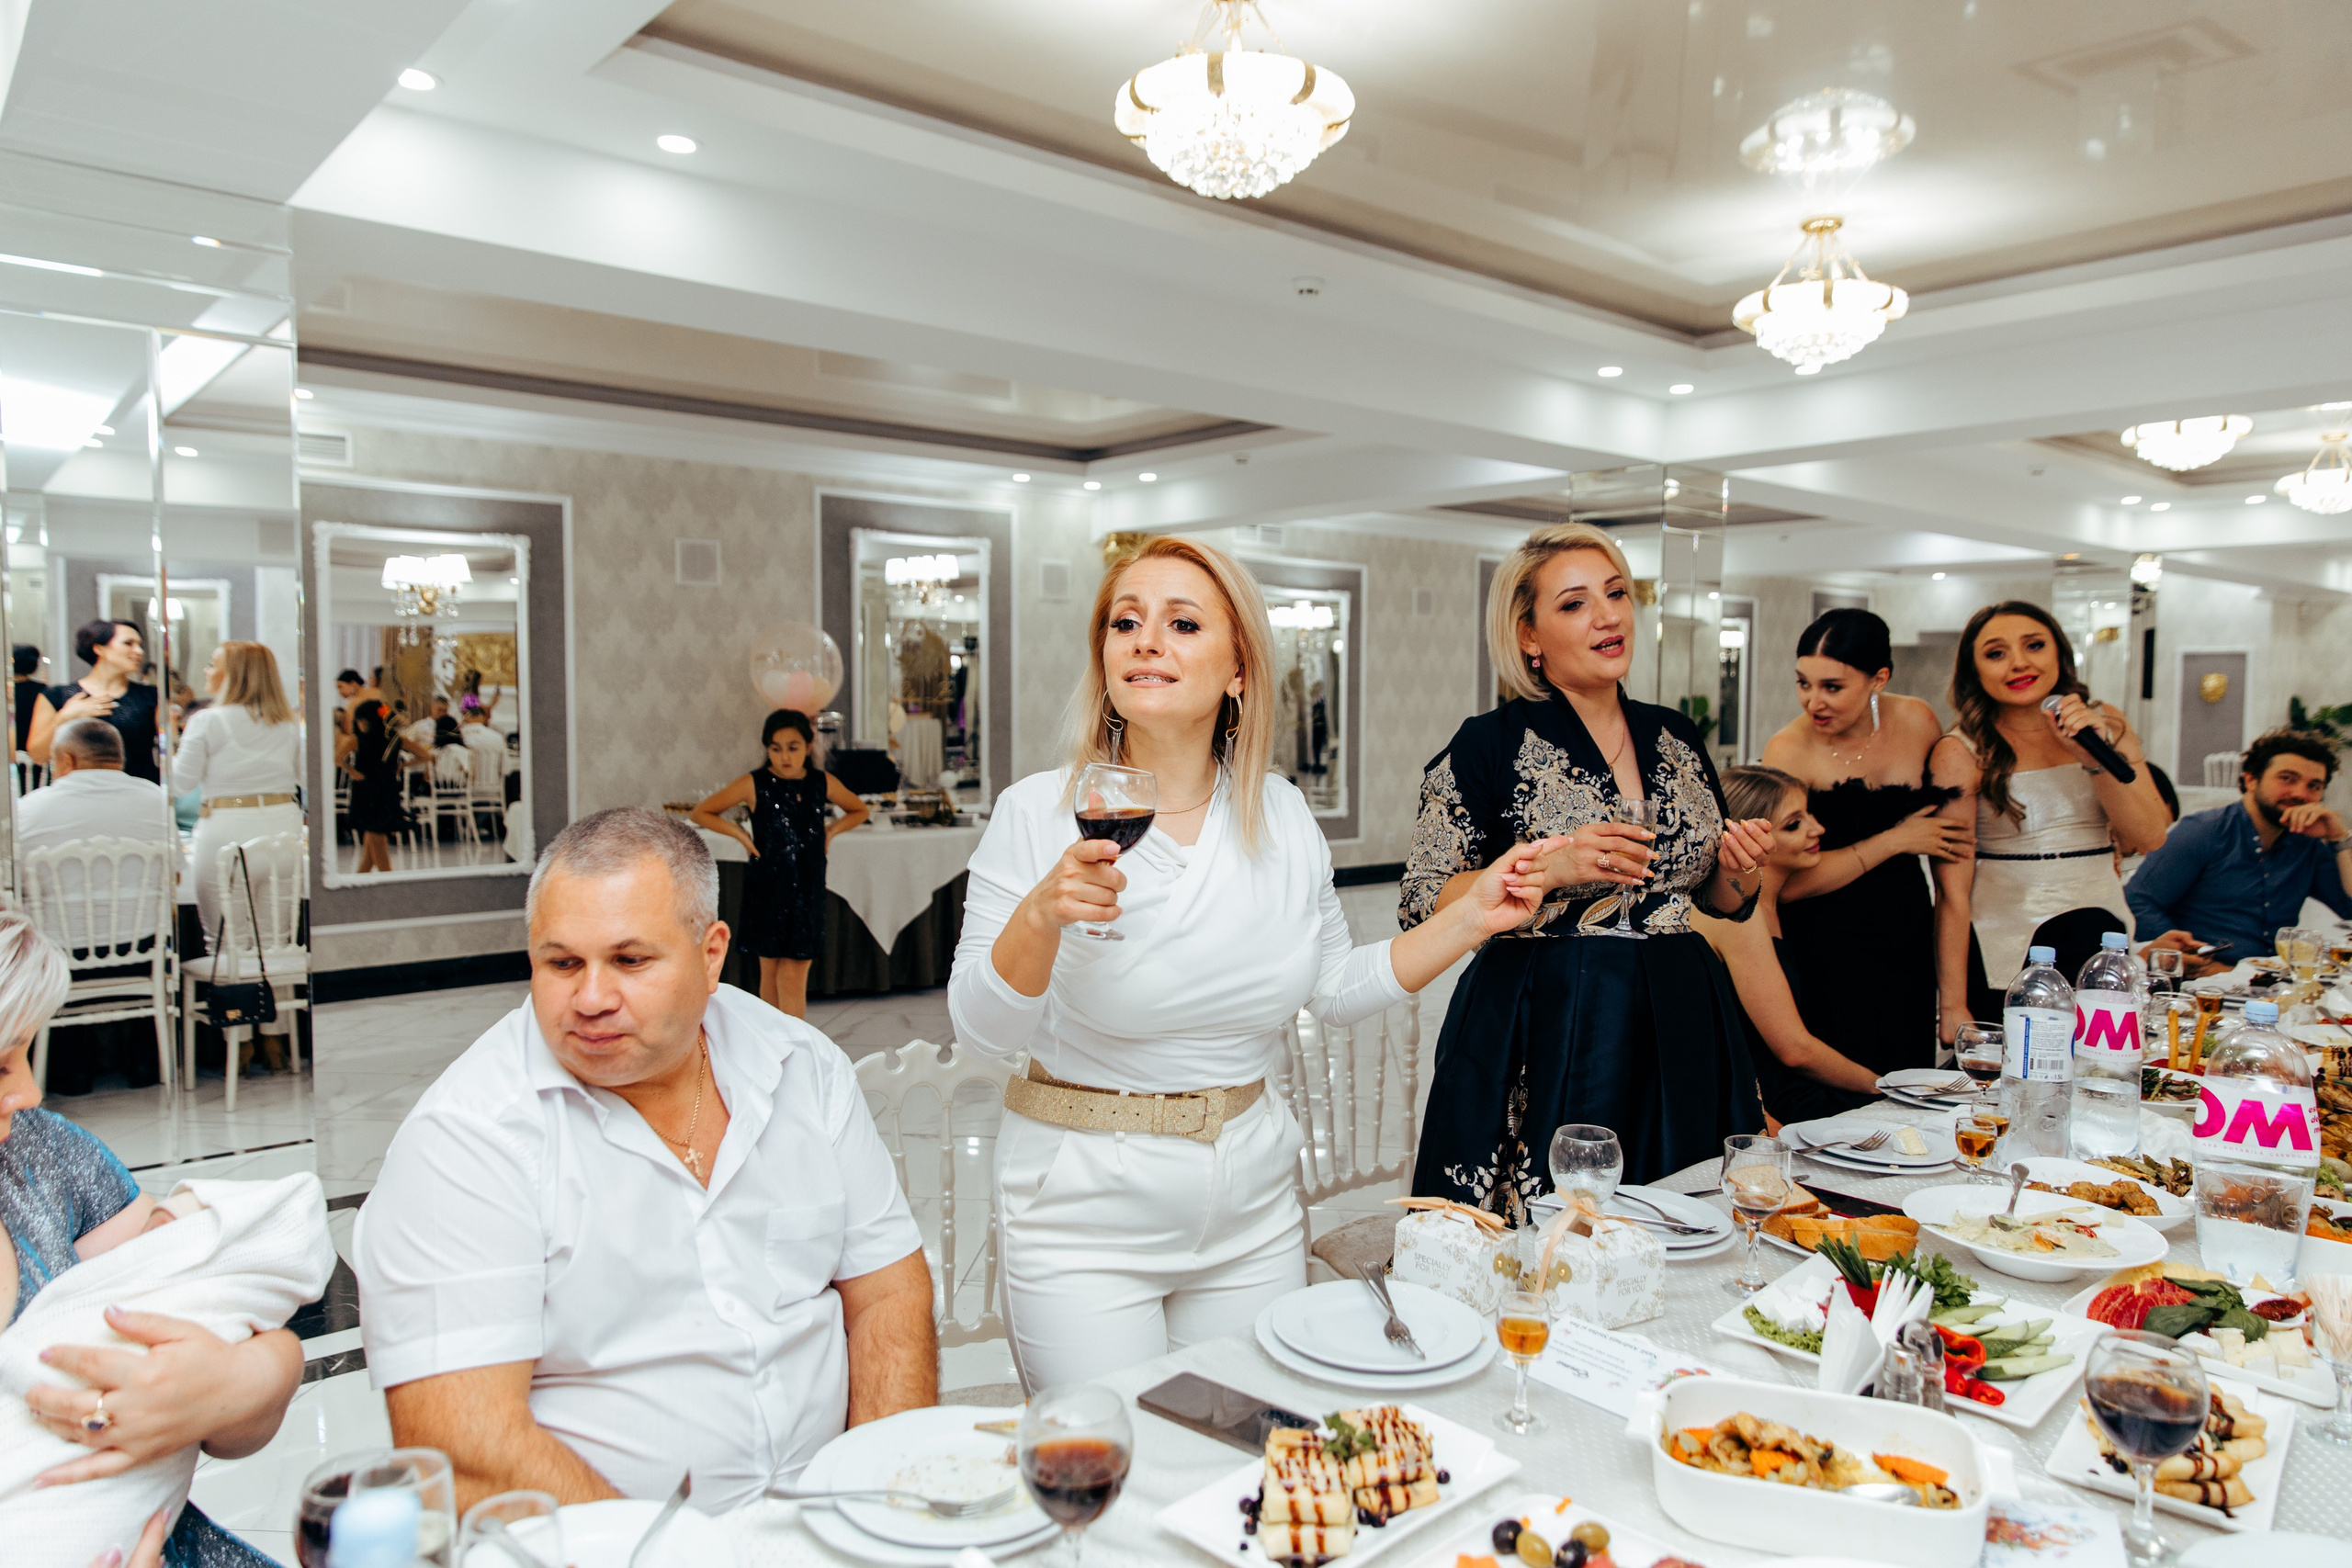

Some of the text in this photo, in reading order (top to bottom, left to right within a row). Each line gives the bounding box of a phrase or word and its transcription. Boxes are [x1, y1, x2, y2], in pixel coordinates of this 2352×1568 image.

[2269, 1152, 2319, 1160] CARBOGAZO
[1414, 1252, 1452, 1272] SPECIALLY
[1415, 1261, 1449, 1280] FOR YOU
[1616, 1274, 1647, 1287] SPECIALLY
[1618, 1283, 1645, 1296] FOR YOU
